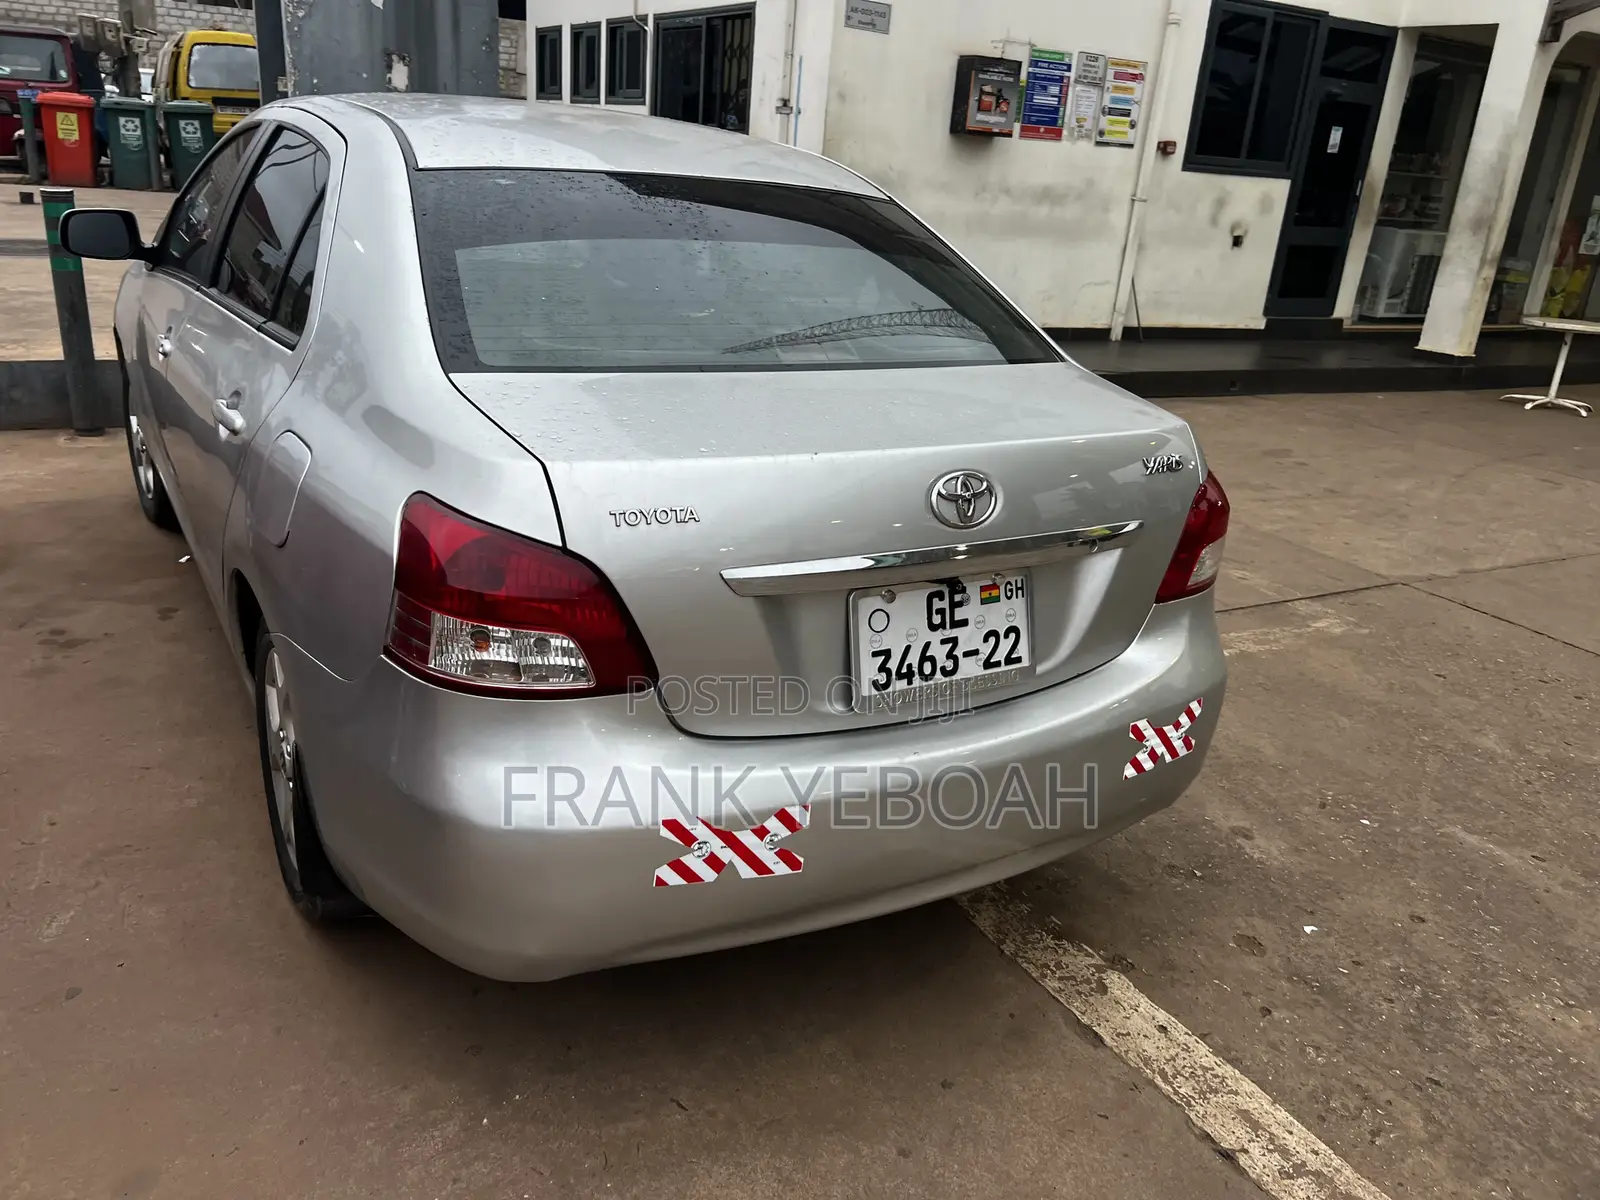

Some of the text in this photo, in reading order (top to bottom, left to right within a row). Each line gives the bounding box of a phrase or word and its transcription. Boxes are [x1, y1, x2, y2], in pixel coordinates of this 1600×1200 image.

[1050, 63, 1068, 71] ACTION
[1142, 453, 1183, 476] YARIS
[609, 505, 700, 527] TOYOTA
[1004, 578, 1025, 601] GH
[926, 587, 969, 632] GE
[871, 625, 1022, 692] 3463-22
